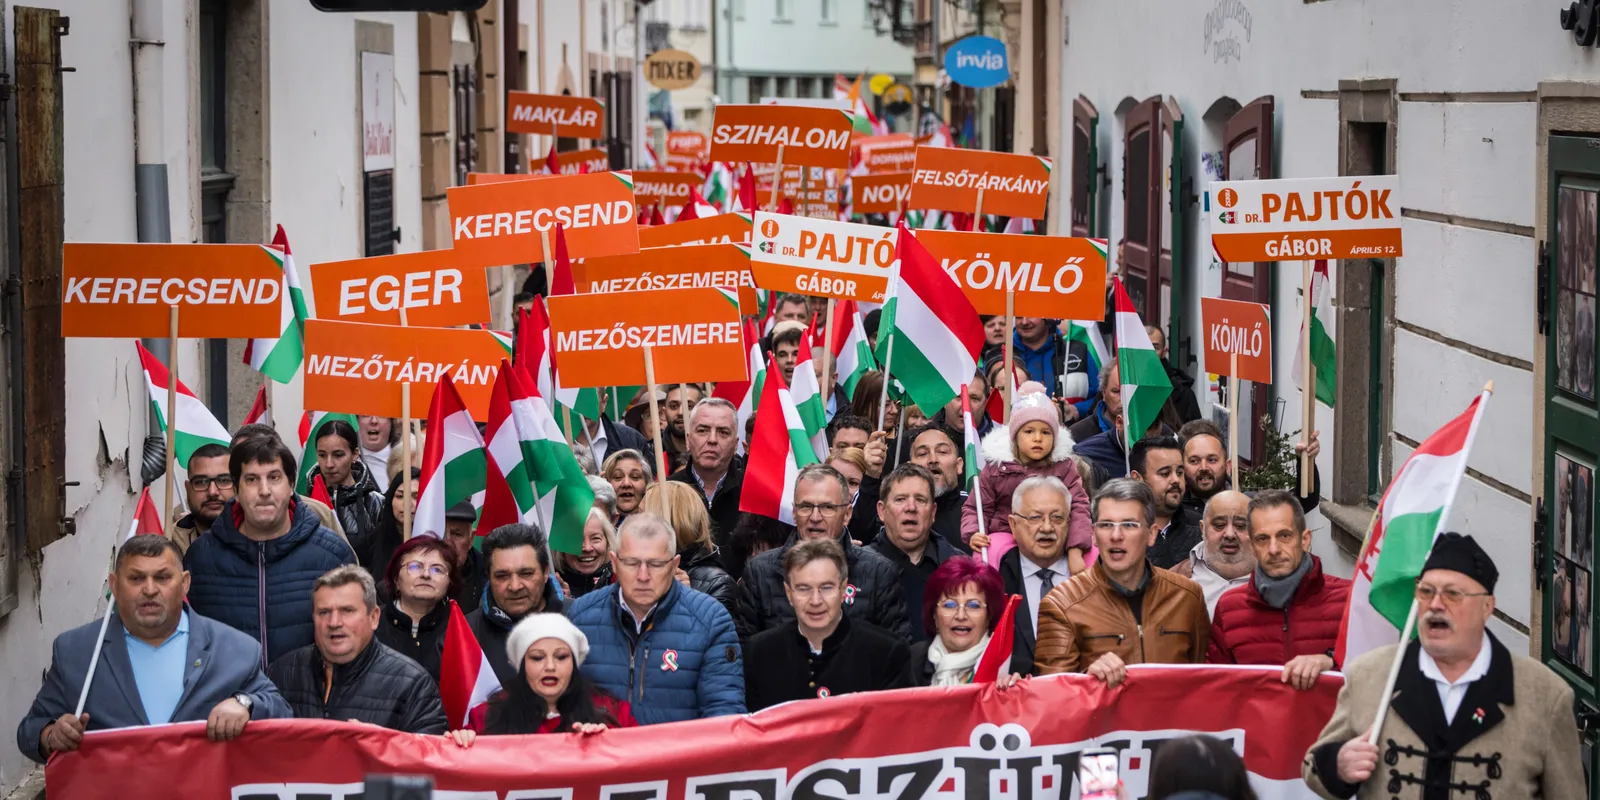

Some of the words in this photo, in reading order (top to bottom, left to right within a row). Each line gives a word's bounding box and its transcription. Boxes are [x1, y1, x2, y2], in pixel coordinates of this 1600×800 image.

[650, 60, 695, 81] MIXER
[957, 51, 1004, 70] invia
[513, 104, 598, 128] MAKLÁR
[713, 124, 850, 150] SZIHALOM
[913, 167, 1049, 196] FELSŐTÁRKÁNY
[1245, 213, 1262, 223] DR.
[1261, 181, 1393, 222] PAJTÓK
[454, 200, 633, 239] KERECSEND
[782, 246, 797, 257] DR.
[798, 230, 896, 269] PAJTÓ
[1265, 235, 1332, 257] GÁBOR
[1350, 245, 1382, 255] ÁPRILIS
[1384, 245, 1396, 254] 12.
[795, 272, 857, 297] GÁBOR
[941, 252, 1084, 294] KÖMLŐ
[64, 276, 280, 305] KERECSEND
[339, 269, 463, 314] EGER
[556, 321, 739, 352] MEZŐSZEMERE
[1211, 318, 1262, 357] KÖMLŐ
[307, 352, 499, 386] MEZŐTÁRKÁN
